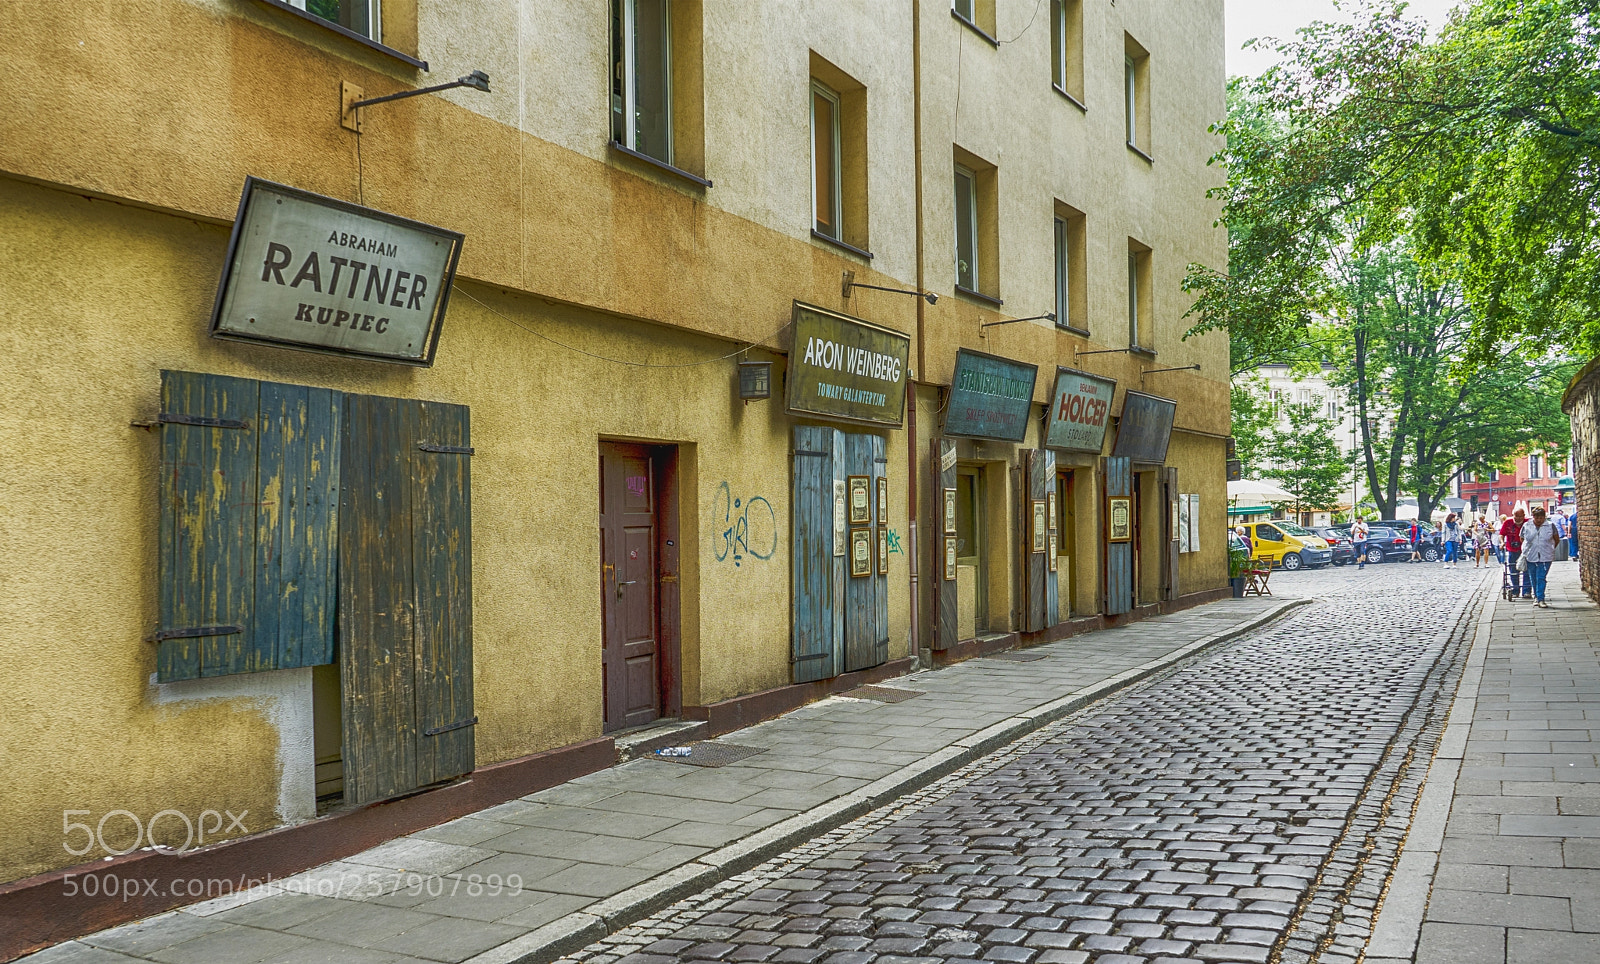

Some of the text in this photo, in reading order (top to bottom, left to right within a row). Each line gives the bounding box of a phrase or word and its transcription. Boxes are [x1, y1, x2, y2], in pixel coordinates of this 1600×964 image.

[328, 230, 398, 258] ABRAHAM
[261, 242, 428, 311] RATTNER
[295, 303, 390, 334] KUPIEC
[803, 337, 901, 383] ARON WEINBERG
[817, 382, 844, 400] TOWARY
[965, 407, 985, 421] SKLEP
